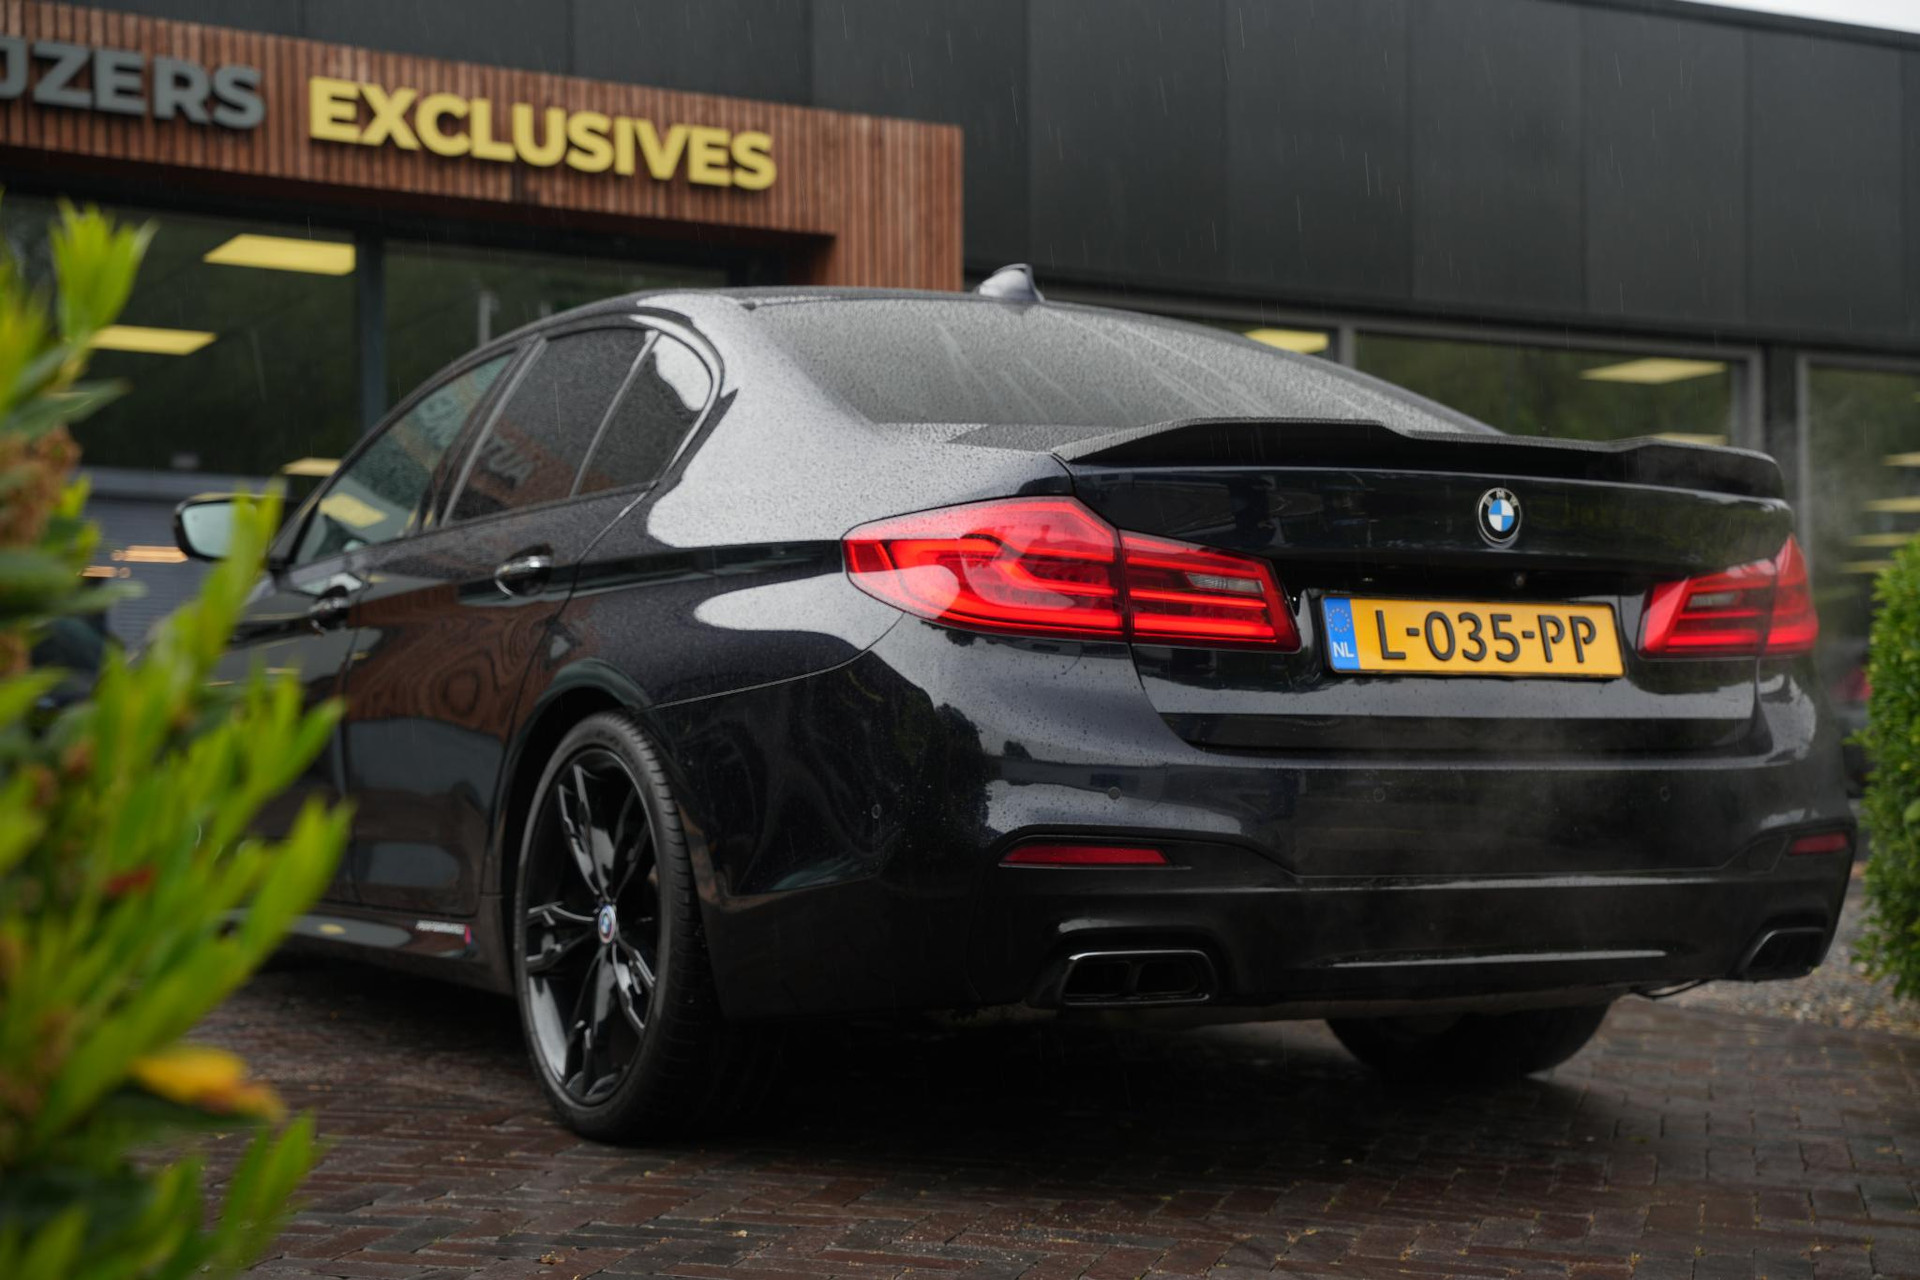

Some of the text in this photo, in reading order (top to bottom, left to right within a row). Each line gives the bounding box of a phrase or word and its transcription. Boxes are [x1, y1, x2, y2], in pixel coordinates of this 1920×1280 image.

[309, 76, 776, 190] EXCLUSIVES
[1333, 640, 1354, 658] NL
[1375, 610, 1596, 663] L-035-PP
